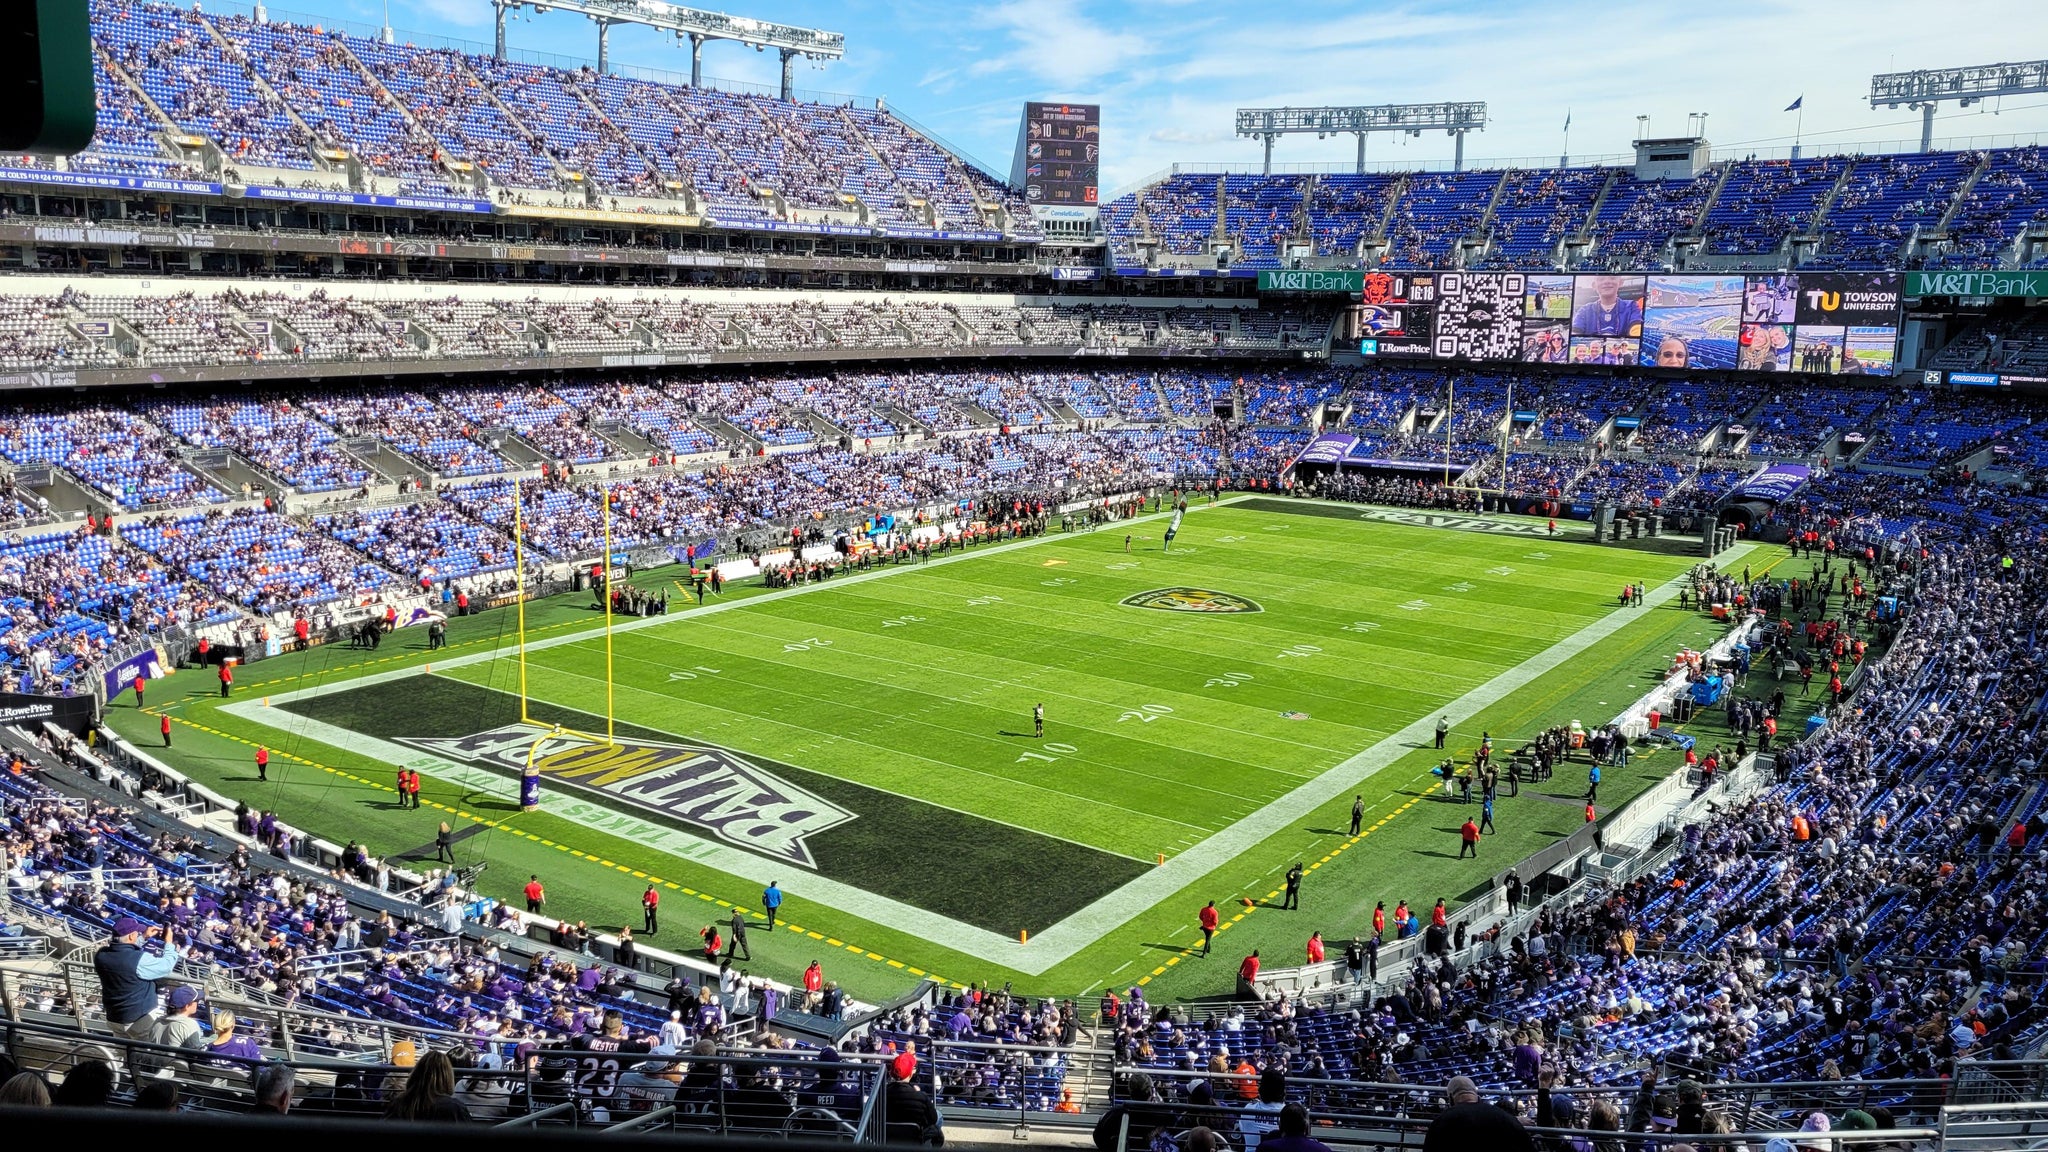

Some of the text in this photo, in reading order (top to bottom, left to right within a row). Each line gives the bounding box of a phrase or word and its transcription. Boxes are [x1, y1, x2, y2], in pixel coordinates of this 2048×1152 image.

[1042, 123, 1052, 138] 10
[1075, 125, 1086, 139] 37
[7, 171, 28, 180] COLTS
[52, 174, 63, 182] #70
[64, 175, 75, 183] #77
[142, 180, 211, 193] ARTHUR B. MODELL
[260, 188, 354, 203] MICHAEL McCRARY 1997-2002
[396, 198, 475, 211] PETER BOULWARE 1997-2005
[1050, 209, 1085, 218] Constellation
[34, 226, 175, 245] PREGAME WARMUPS PRESENTED BY
[508, 248, 536, 260] PREGAME
[1268, 271, 1354, 290] M&T Bank
[1394, 278, 1404, 297] 0
[1412, 277, 1433, 286] PREGAME
[1918, 273, 2041, 296] M&T Bank
[1410, 285, 1434, 301] 16:18
[1806, 290, 1841, 312] TU
[1844, 291, 1897, 302] TOWSON
[1843, 302, 1897, 311] UNIVERSITY
[1393, 311, 1402, 329] 0
[602, 355, 633, 367] PREGAME
[633, 354, 666, 366] WARMUPS
[53, 377, 77, 386] clubs
[1925, 372, 1940, 383] 25
[1950, 374, 1998, 384] PROGRESSIVE
[1367, 509, 1564, 536] RAVENS
[1343, 620, 1382, 634] 50
[783, 636, 834, 653] 20
[1279, 643, 1323, 659] 40
[667, 665, 722, 683] 10
[1206, 671, 1254, 688] 30
[1120, 703, 1174, 724] 20
[1018, 742, 1078, 763] 10
[407, 757, 455, 774] US
[408, 724, 842, 865] BALTIMORE
[561, 803, 671, 844] TAKES
[671, 840, 723, 859] IT
[1834, 1001, 1843, 1015] 8
[590, 1039, 620, 1053] HESTER
[1851, 1042, 1864, 1055] 41
[577, 1057, 620, 1097] 23
[622, 1084, 646, 1098] CHICAGO
[645, 1090, 666, 1101] BEARS
[817, 1095, 835, 1105] REED
